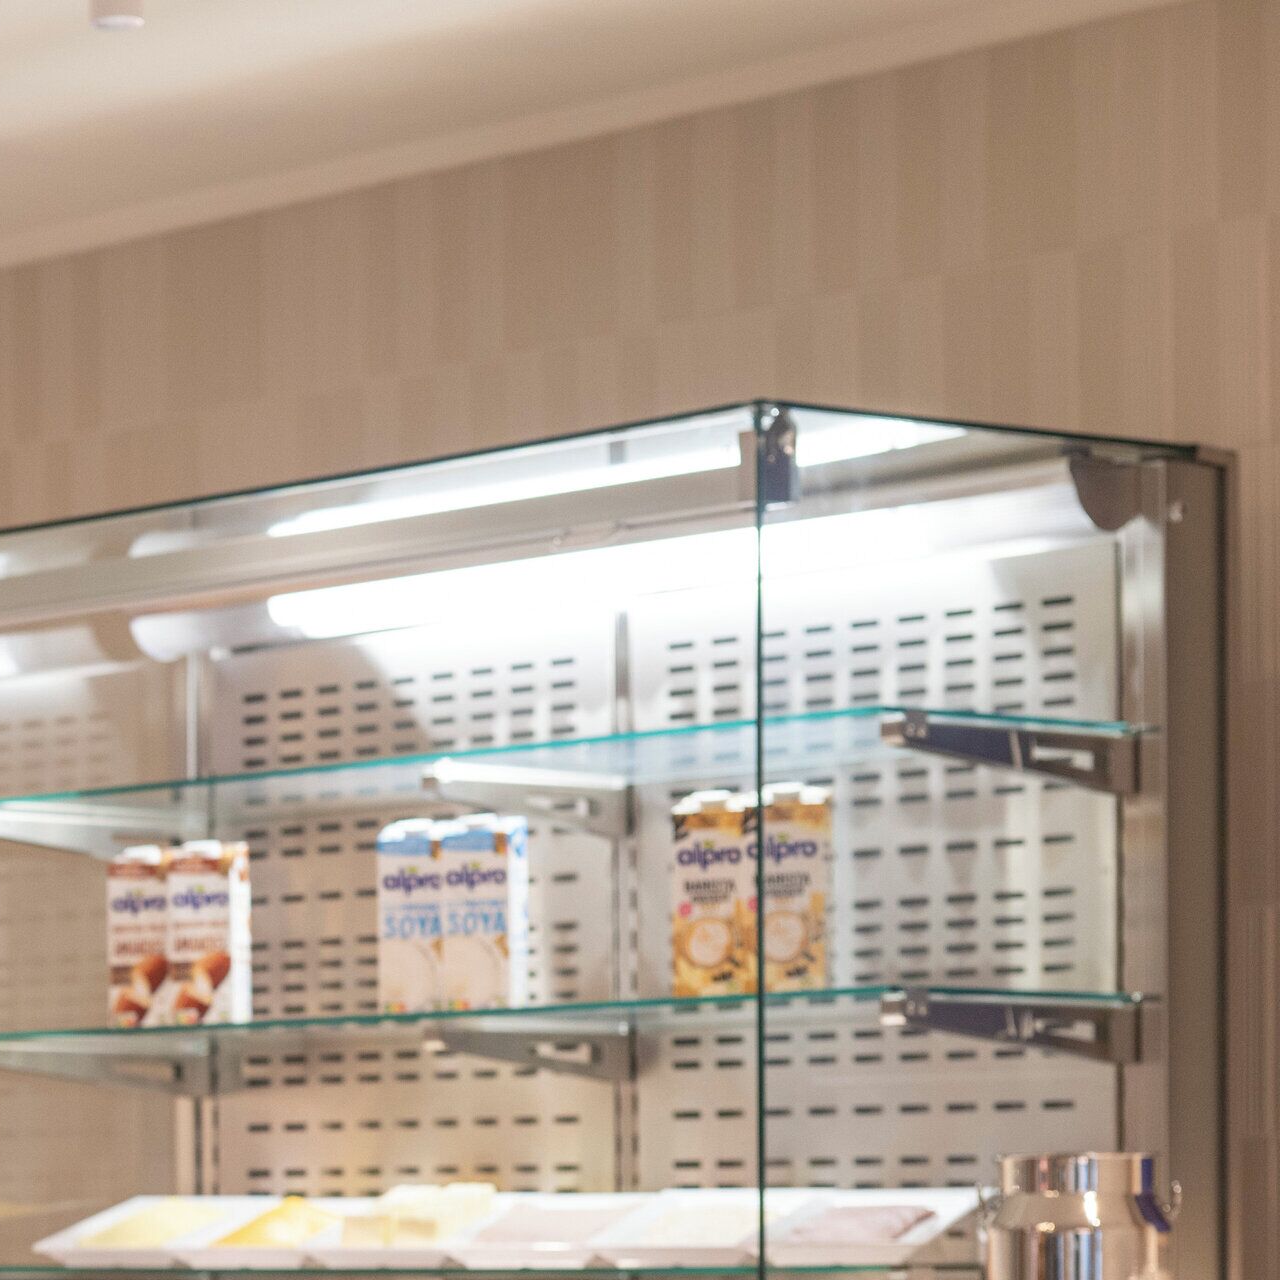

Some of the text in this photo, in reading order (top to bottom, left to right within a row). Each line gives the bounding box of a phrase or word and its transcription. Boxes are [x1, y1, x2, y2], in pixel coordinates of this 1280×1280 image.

[677, 842, 741, 870] alpro
[746, 834, 818, 864] alpro
[383, 866, 441, 897] alpro
[445, 862, 507, 892] alpro
[171, 885, 230, 912] alpro
[383, 913, 441, 938] SOYA
[446, 909, 507, 936] SOYA
